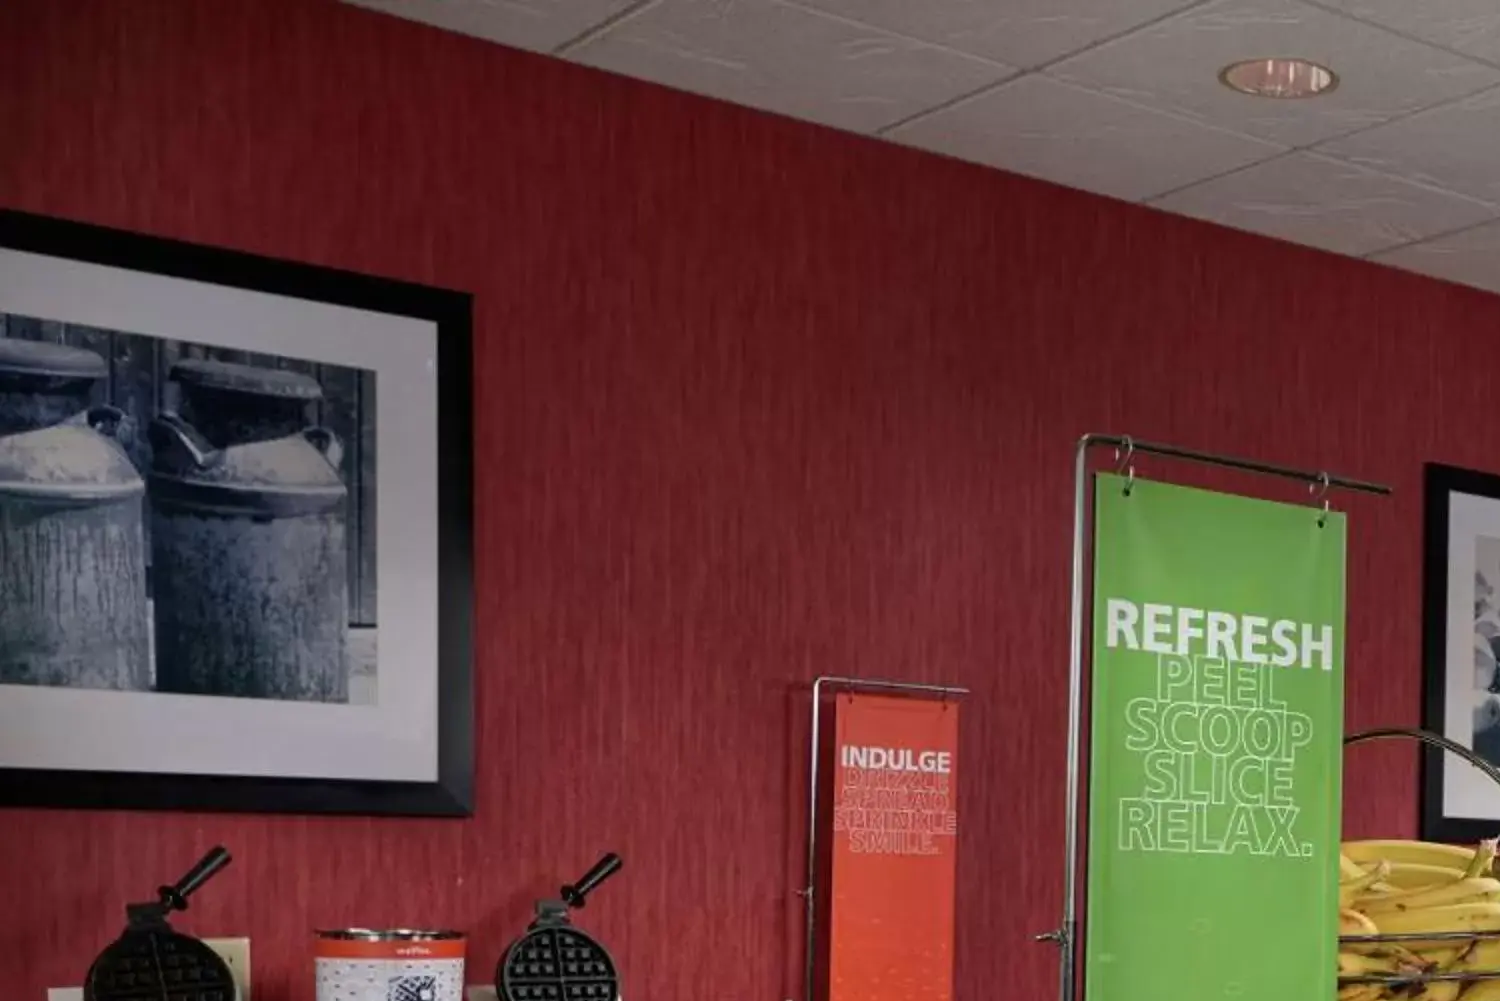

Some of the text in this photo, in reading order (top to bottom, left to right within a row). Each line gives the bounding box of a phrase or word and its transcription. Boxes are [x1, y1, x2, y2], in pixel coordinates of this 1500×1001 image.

[1107, 598, 1332, 671] REFRESH
[1157, 653, 1287, 709] PEEL
[1125, 697, 1314, 760] SCOOP
[841, 745, 951, 773] INDULGE
[1143, 749, 1295, 808] SLICE
[833, 808, 957, 834] SPRINKLE
[842, 788, 949, 812] SPREAD
[1117, 797, 1315, 857] RELAX.
